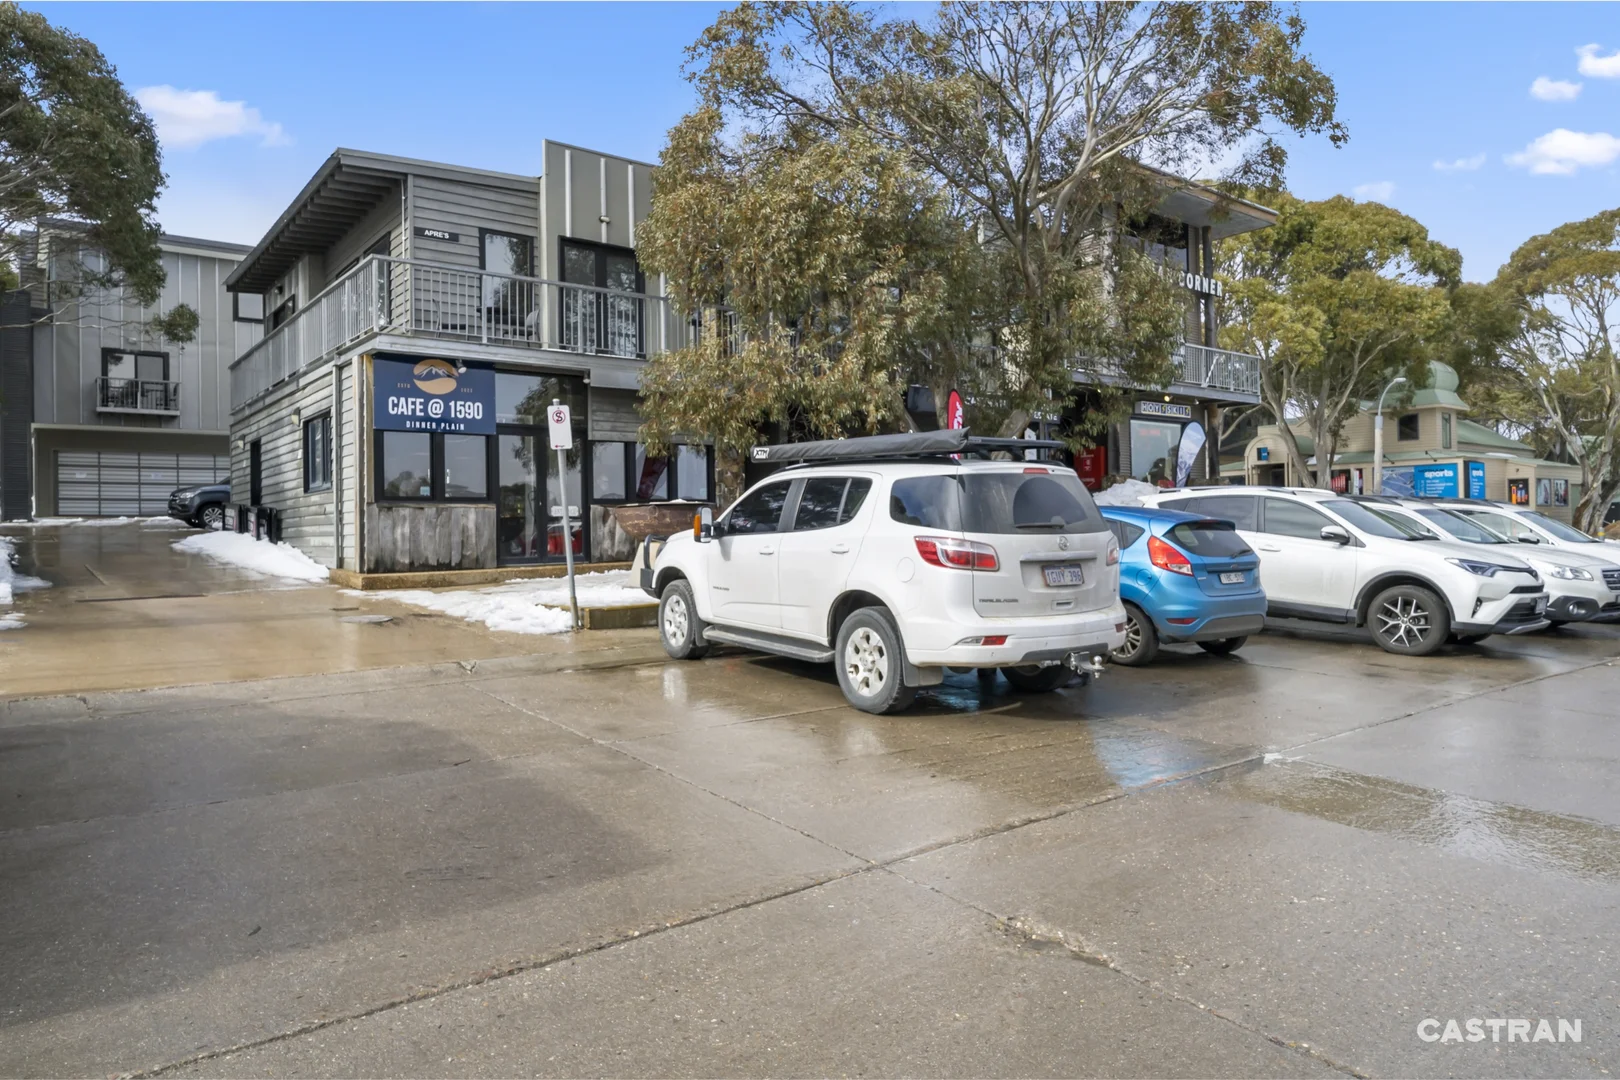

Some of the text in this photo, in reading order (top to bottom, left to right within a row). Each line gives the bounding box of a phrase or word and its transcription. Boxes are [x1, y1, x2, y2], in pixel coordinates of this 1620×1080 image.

[424, 229, 450, 239] APRE'S
[388, 396, 483, 420] CAFE @ 1590
[406, 420, 465, 431] DINNER PLAIN
[1424, 469, 1454, 478] sports
